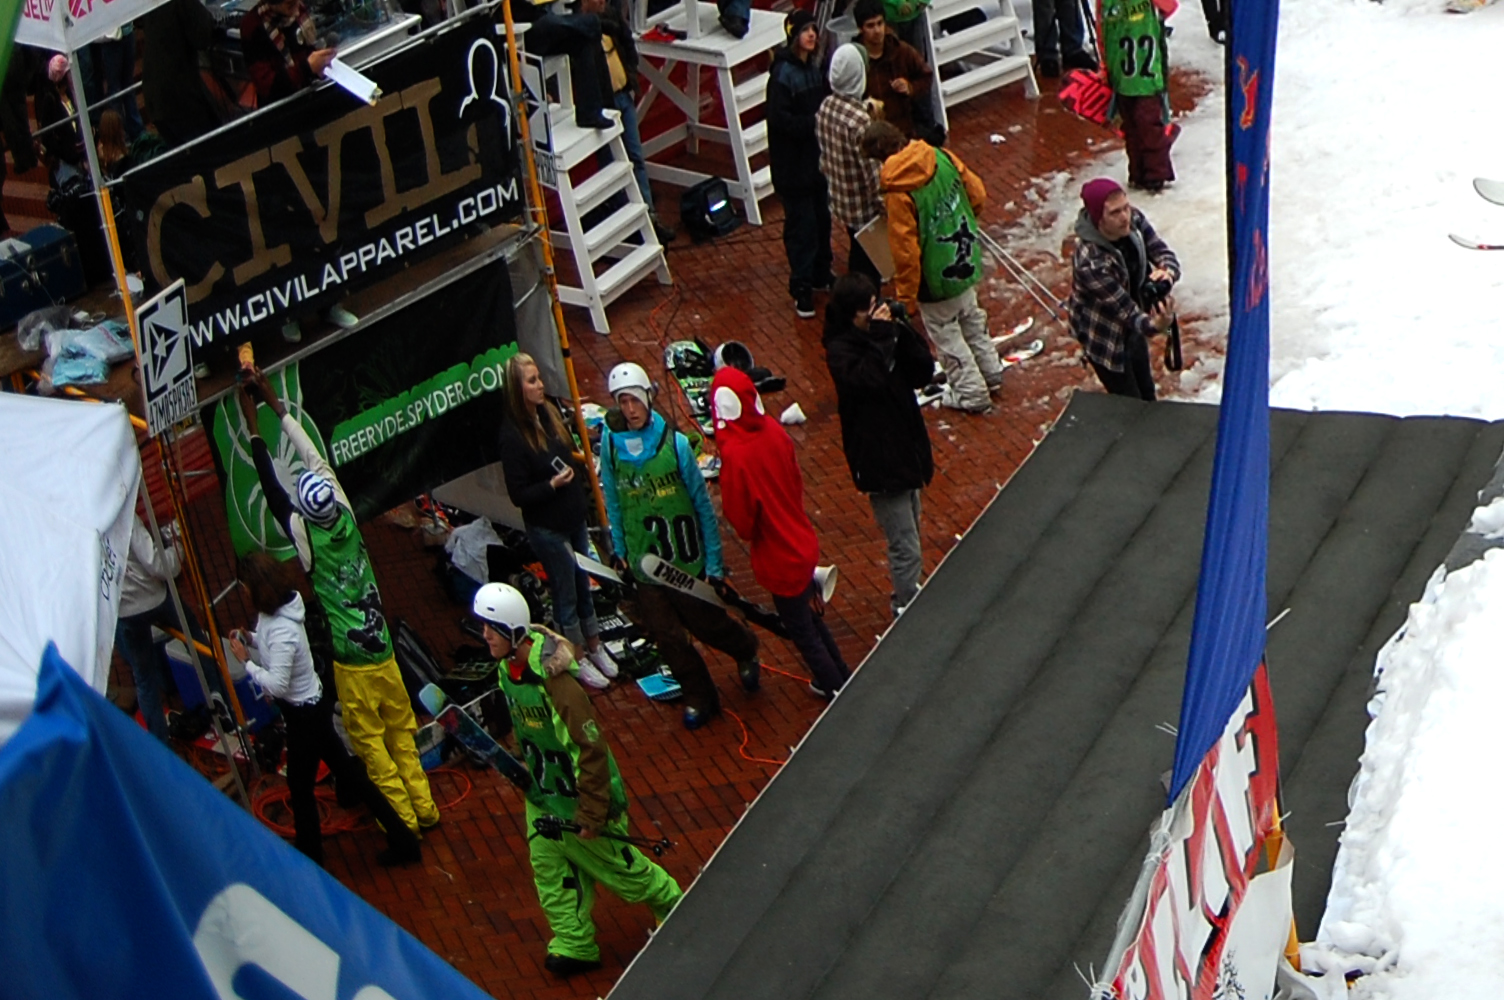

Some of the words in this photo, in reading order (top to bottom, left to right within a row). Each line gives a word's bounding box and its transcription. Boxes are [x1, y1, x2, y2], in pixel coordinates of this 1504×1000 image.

[1119, 34, 1159, 78] 32
[146, 76, 483, 304] CIVIL
[188, 177, 520, 349] WW.CIVILAPPAREL.COM
[643, 514, 701, 565] 30
